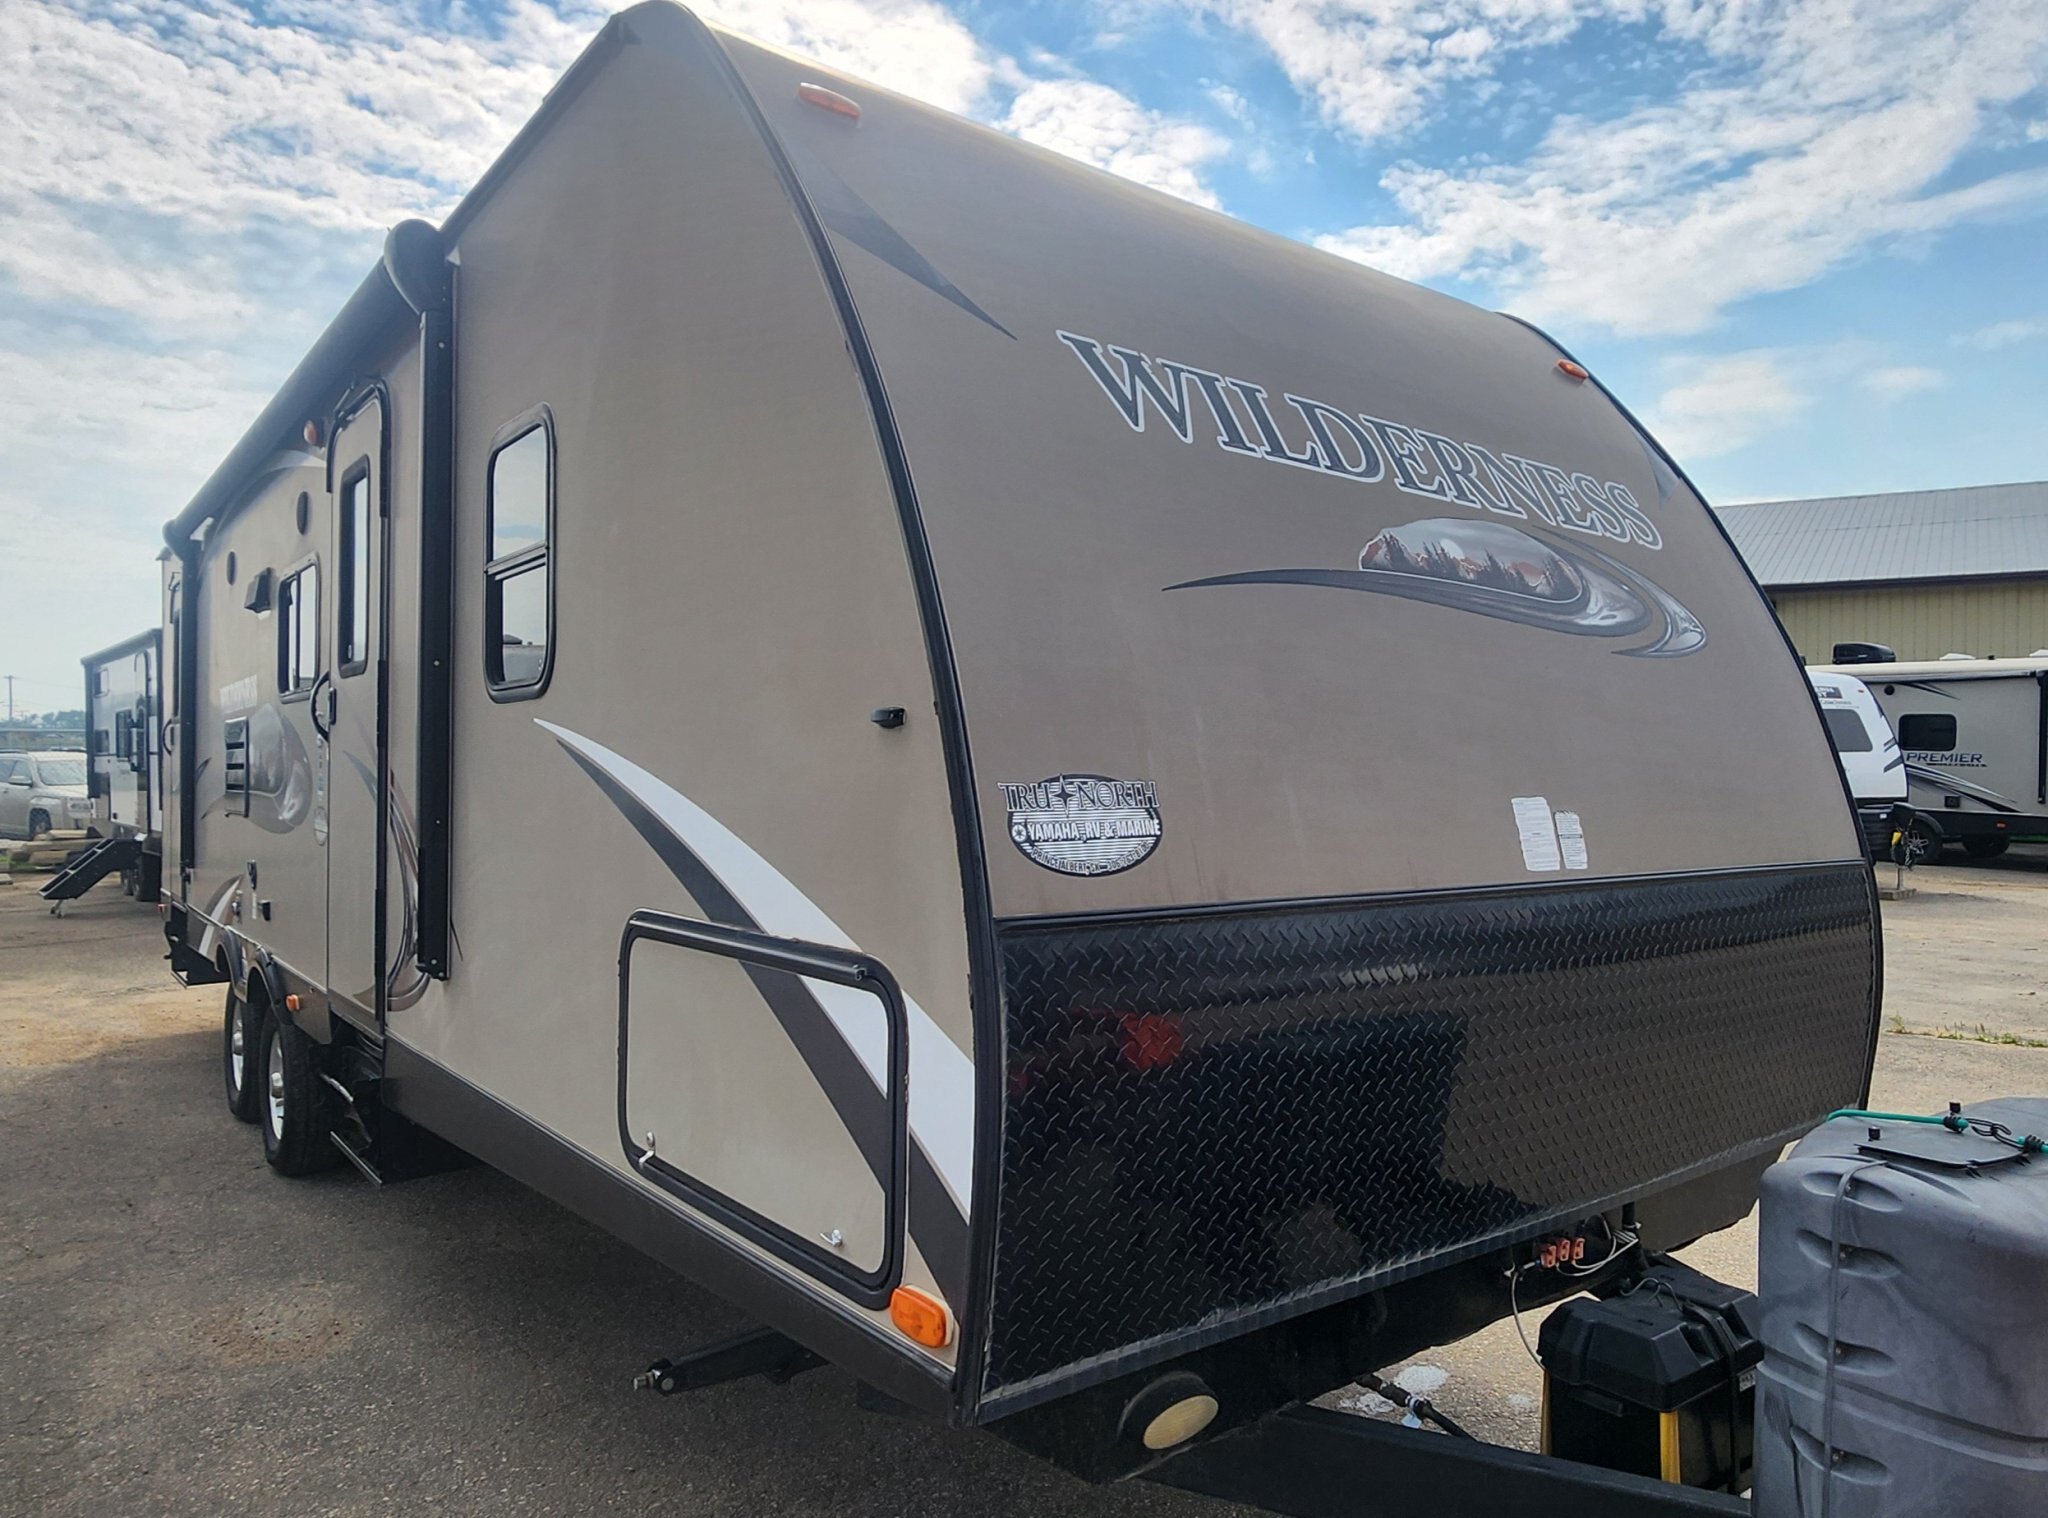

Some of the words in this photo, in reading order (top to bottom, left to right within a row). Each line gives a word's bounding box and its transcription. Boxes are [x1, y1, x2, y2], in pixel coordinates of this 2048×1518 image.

[1056, 330, 1662, 550] WILDERNESS
[1906, 752, 1983, 763] PREMIER
[1073, 780, 1159, 809] NORTH
[1084, 820, 1101, 840] RV
[1104, 820, 1117, 839] &
[1116, 817, 1162, 838] MARINE
[1031, 846, 1059, 868] PRINCE
